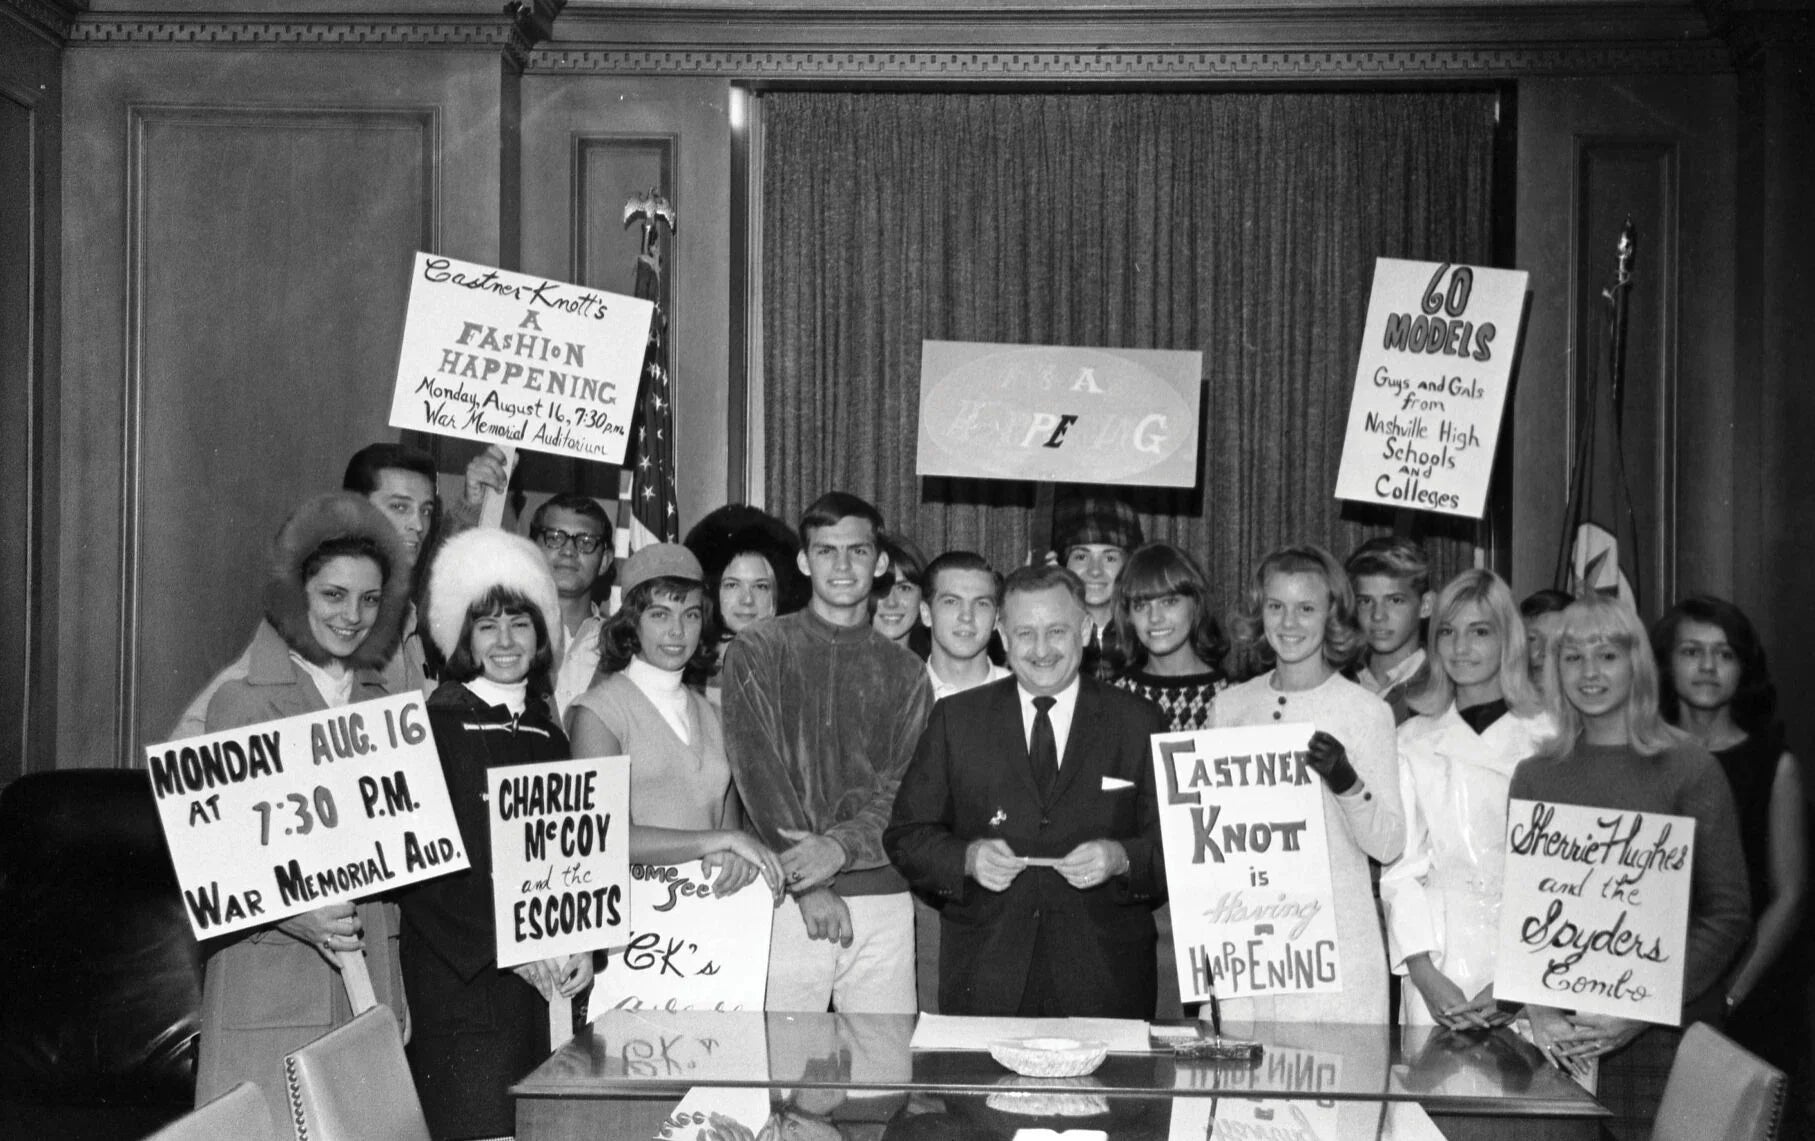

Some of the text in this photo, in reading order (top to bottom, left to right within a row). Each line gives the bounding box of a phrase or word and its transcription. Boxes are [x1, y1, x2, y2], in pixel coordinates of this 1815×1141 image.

[424, 258, 608, 319] Castner-Knott's
[1421, 263, 1473, 317] 60
[519, 309, 543, 332] A
[1384, 313, 1496, 361] MODELS
[415, 376, 480, 412] Monday,
[482, 390, 544, 418] August
[438, 348, 617, 405] HAPPENING
[1374, 366, 1410, 396] Guys
[1401, 392, 1446, 412] from
[423, 400, 609, 456] War Memorial Auditorium
[1383, 437, 1455, 468] Schools
[1439, 420, 1480, 450] High
[1375, 474, 1459, 510] Colleges
[150, 703, 426, 799] MONDAY AUG. 16
[190, 771, 420, 846] AT 7:30 P.M.
[499, 770, 597, 821] CHARLIE
[525, 813, 611, 862] McCOY
[1189, 804, 1307, 865] KNOTT
[1510, 802, 1689, 885] Sherrie Hughes
[521, 862, 593, 894] and the
[652, 878, 711, 912] See
[1538, 867, 1642, 906] and the
[514, 884, 622, 943] ESCORTS
[1519, 898, 1670, 964] Spyders
[1188, 939, 1336, 996] HAPPENING
[1542, 952, 1652, 1001] Combo
